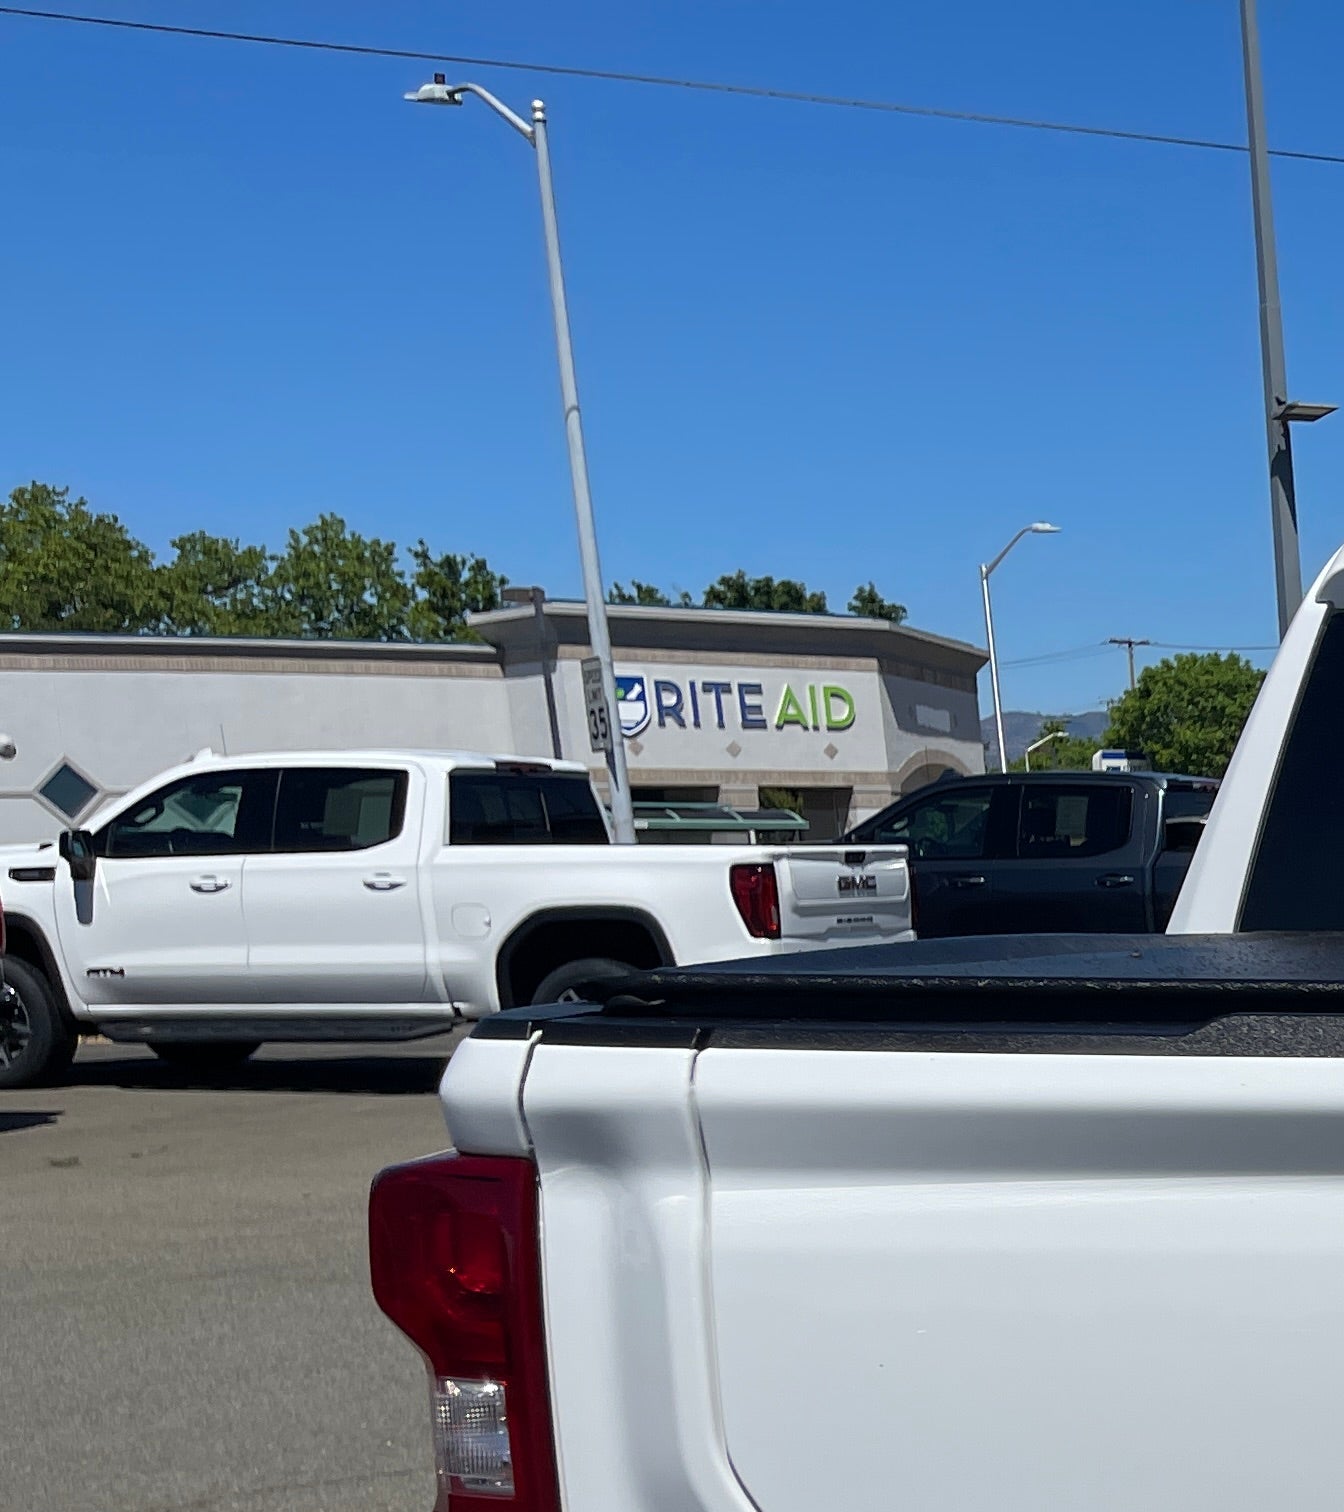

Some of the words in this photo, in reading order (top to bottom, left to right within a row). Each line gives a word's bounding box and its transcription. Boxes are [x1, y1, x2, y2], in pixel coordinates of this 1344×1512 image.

[654, 680, 767, 730] RITE
[774, 682, 856, 731] AID
[589, 707, 608, 740] 35
[838, 875, 877, 891] GMC
